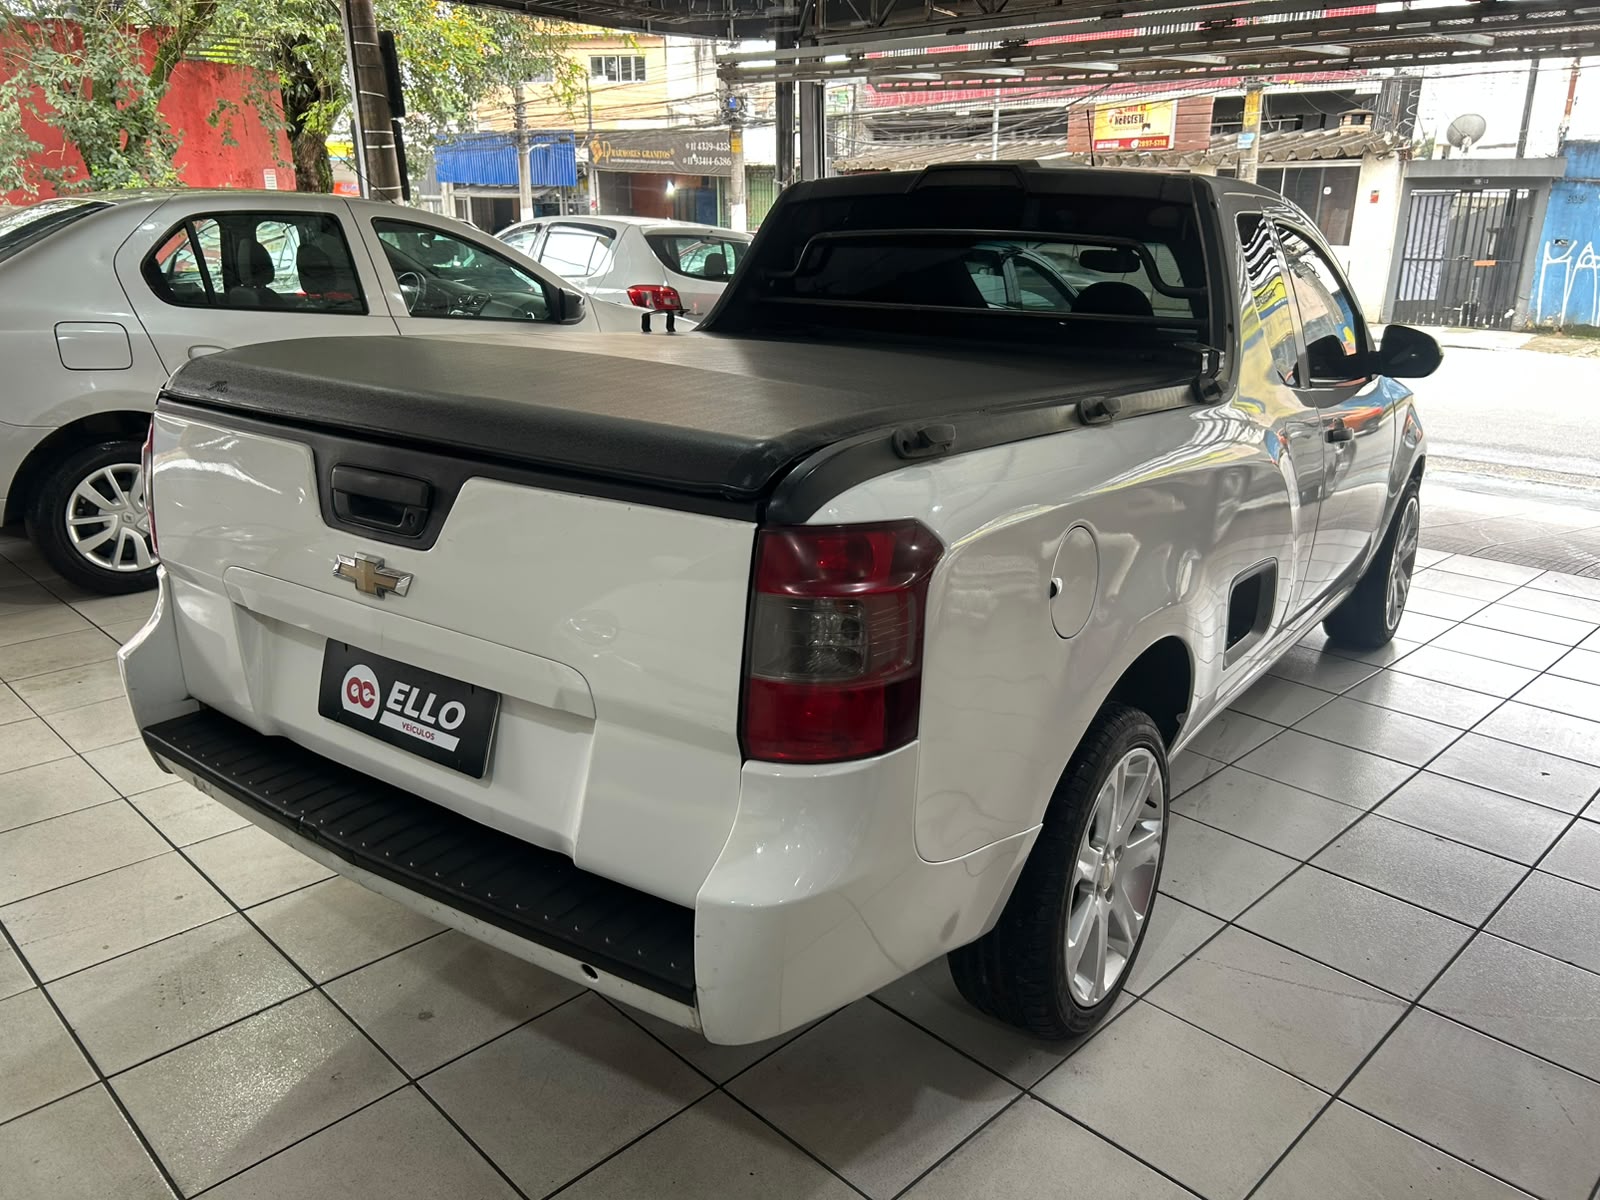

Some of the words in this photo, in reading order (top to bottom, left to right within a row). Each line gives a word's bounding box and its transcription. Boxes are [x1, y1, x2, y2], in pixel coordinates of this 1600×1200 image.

[690, 142, 697, 151] 11
[641, 150, 671, 159] GRANITOS
[385, 680, 466, 730] ELLO
[401, 720, 435, 741] VEÍCULOS
